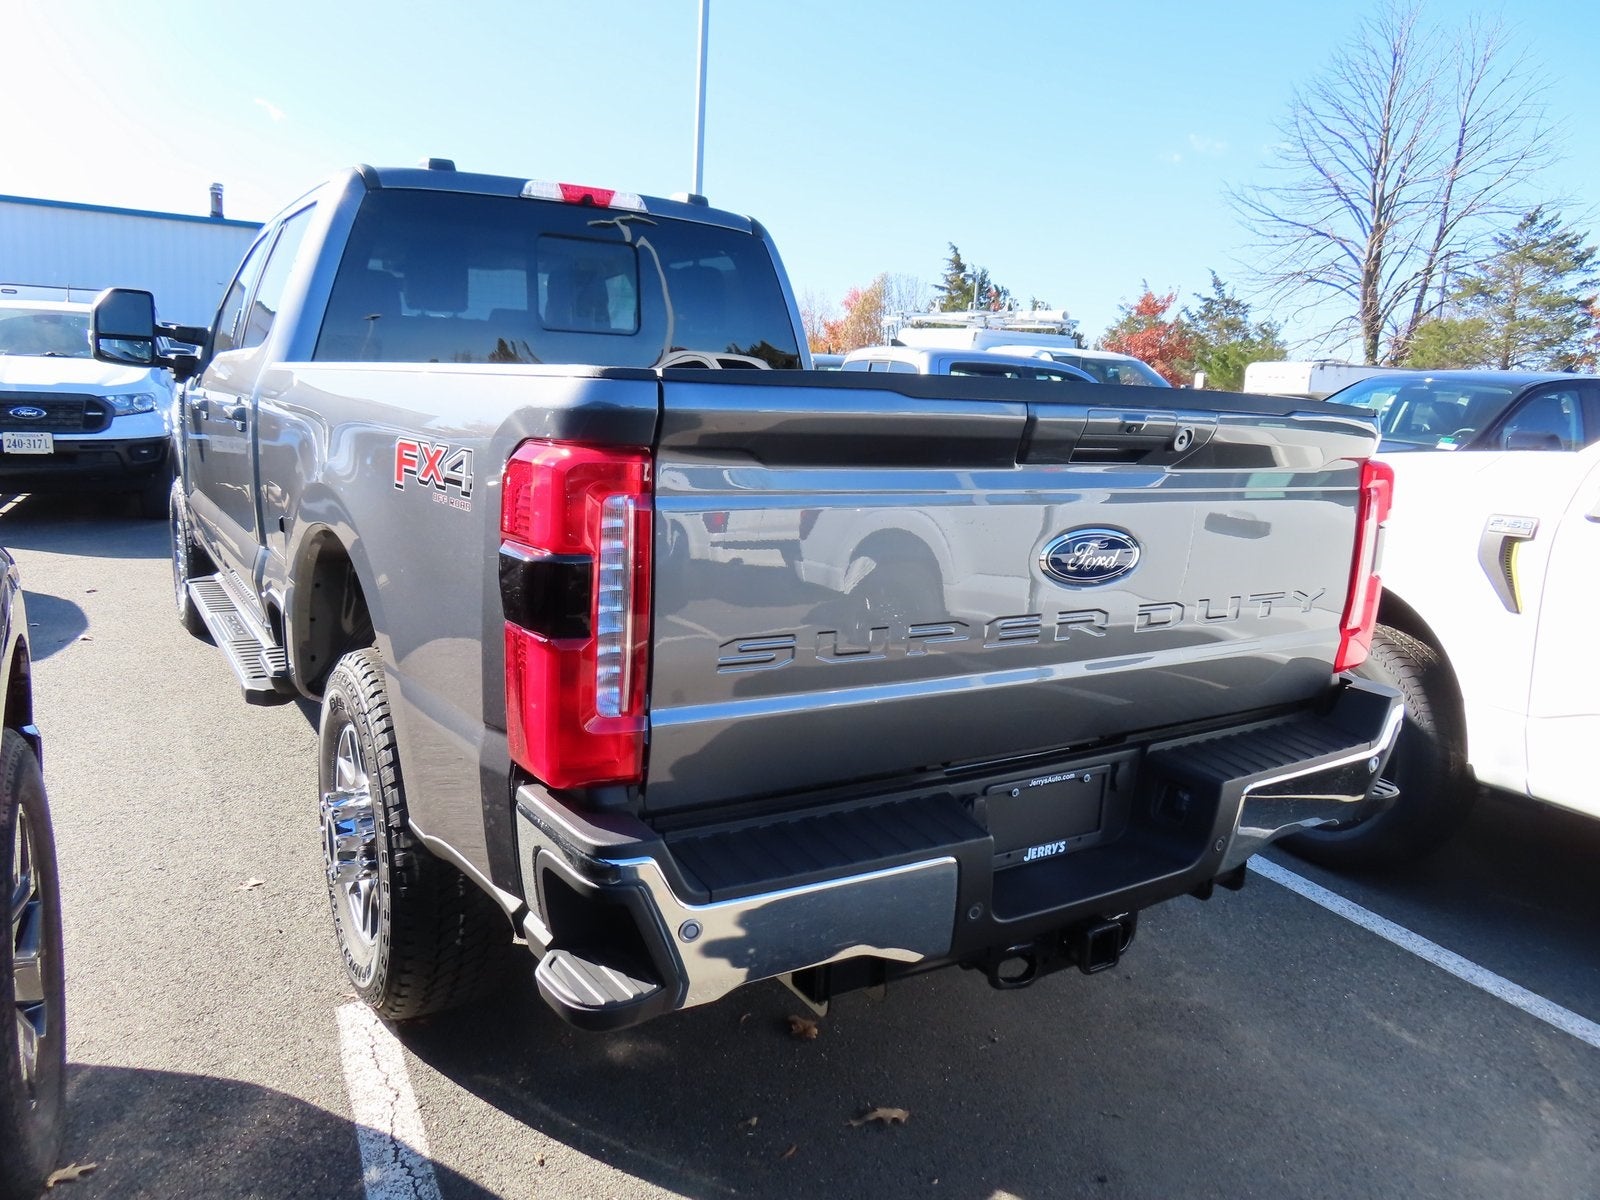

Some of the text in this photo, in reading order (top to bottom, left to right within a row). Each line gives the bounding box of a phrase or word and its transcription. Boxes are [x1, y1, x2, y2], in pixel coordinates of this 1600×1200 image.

[394, 436, 474, 499] FX4
[1067, 540, 1120, 571] Ford
[716, 587, 1327, 675] SUPER DUTY
[1029, 773, 1076, 788] JerrysAuto.com
[1023, 840, 1066, 862] JERRY'S
